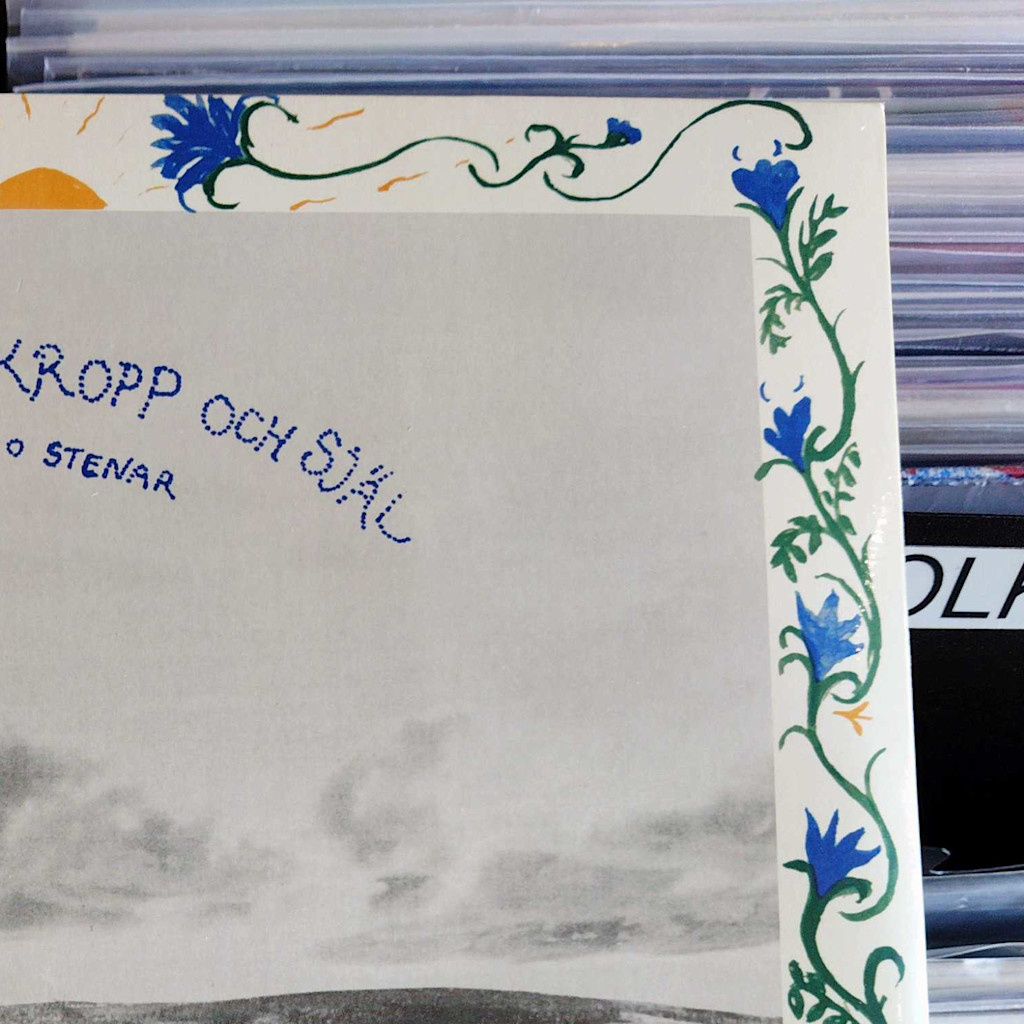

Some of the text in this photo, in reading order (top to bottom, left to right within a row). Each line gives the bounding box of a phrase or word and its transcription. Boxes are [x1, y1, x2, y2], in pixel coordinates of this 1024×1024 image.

[43, 440, 176, 500] STENAR
[201, 394, 298, 462] OCH
[300, 428, 412, 543] SJÄL
